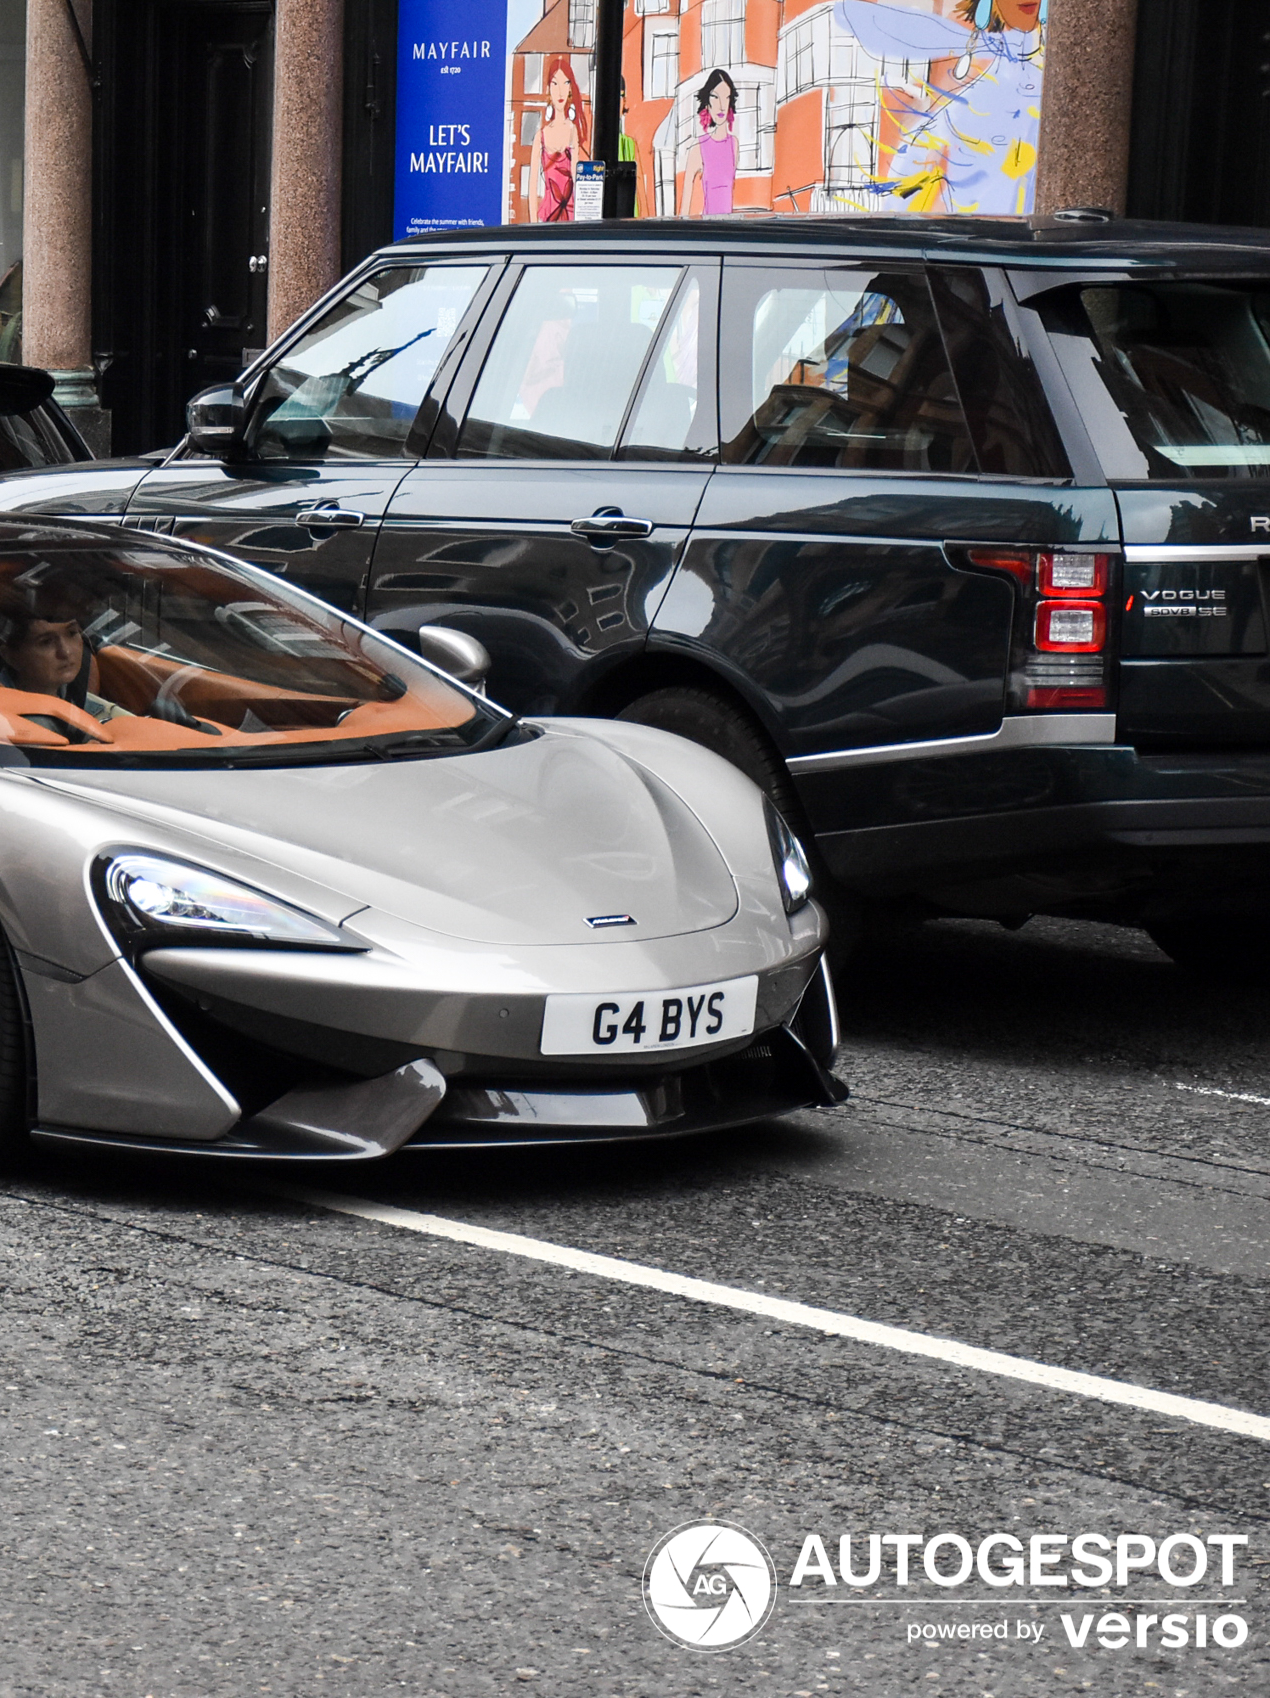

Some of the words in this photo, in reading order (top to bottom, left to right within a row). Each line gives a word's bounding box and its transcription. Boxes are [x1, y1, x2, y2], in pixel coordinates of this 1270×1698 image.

[412, 41, 491, 60] MAYFAIR
[410, 151, 489, 173] MAYFAIR!
[576, 173, 604, 181] Pay-to-Park
[410, 217, 431, 225] Celebrate
[406, 226, 420, 235] family
[1140, 590, 1226, 600] VOGUE
[1150, 607, 1190, 616] SDV8
[1198, 607, 1227, 616] SE
[592, 1001, 646, 1046] G4
[658, 991, 725, 1042] BYS
